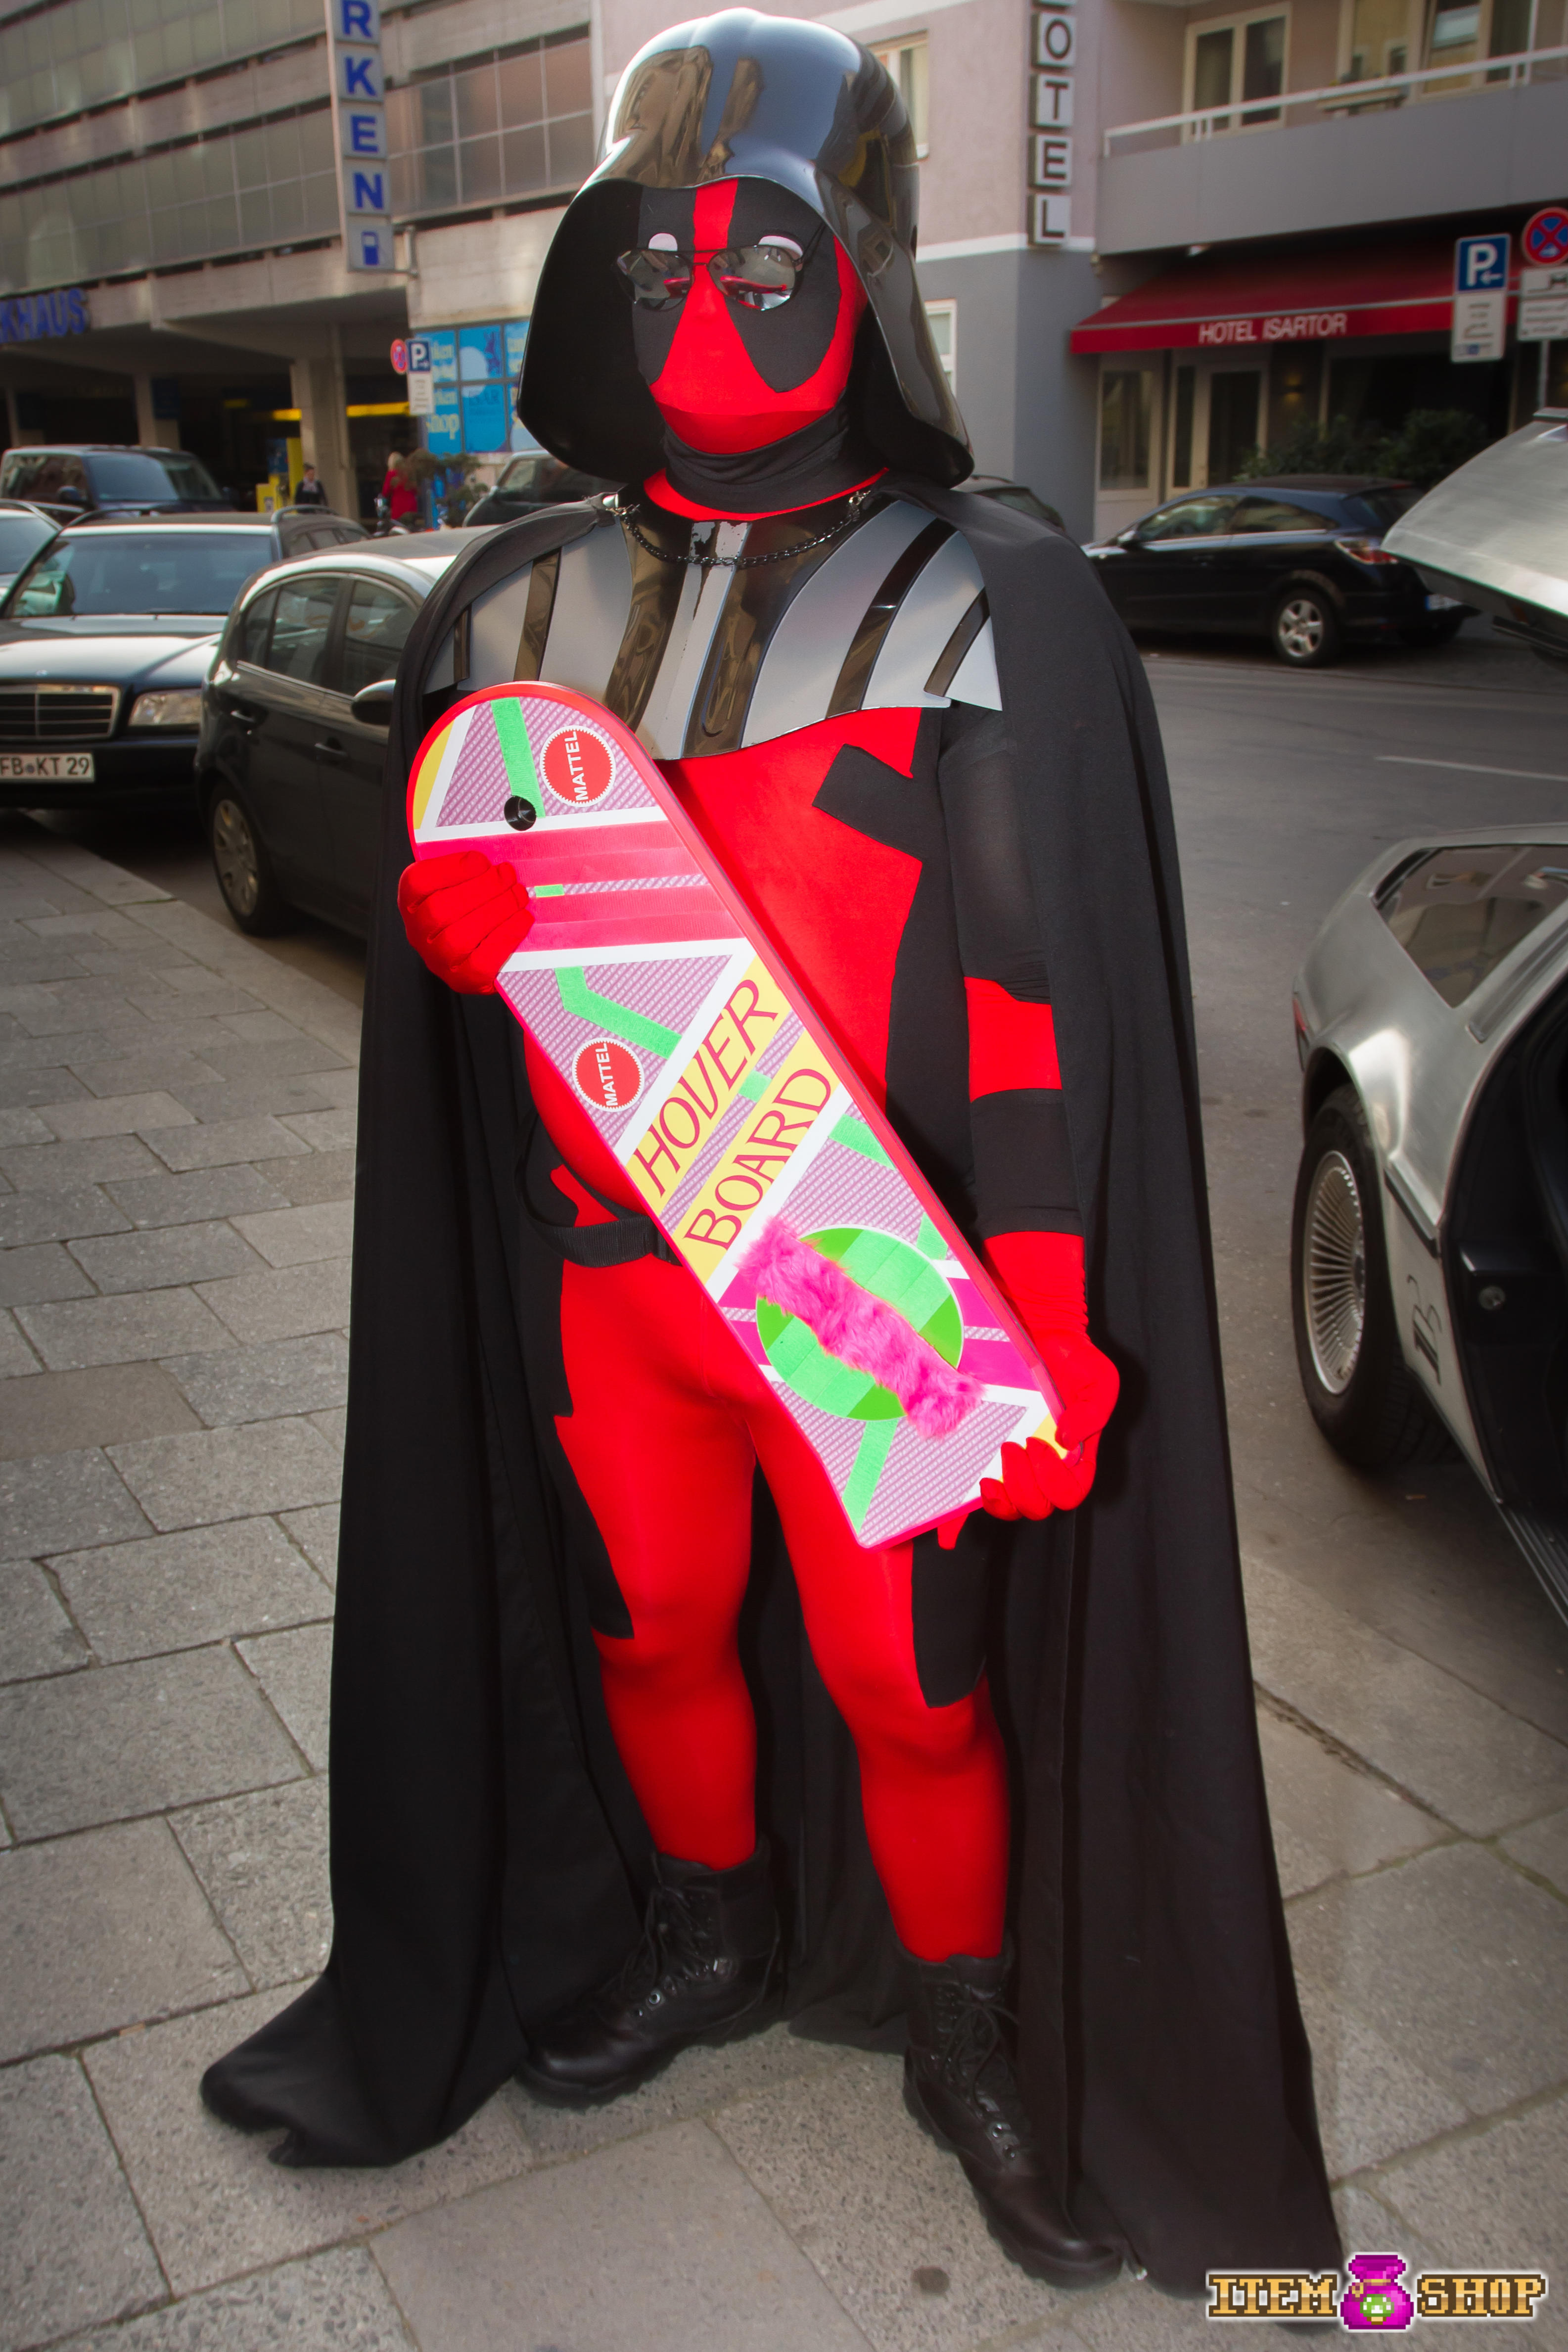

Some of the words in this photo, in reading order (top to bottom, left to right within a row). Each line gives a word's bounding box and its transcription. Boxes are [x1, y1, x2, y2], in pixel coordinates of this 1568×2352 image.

[1042, 18, 1072, 238] OTEL
[1467, 243, 1498, 286] P
[1198, 320, 1257, 343] HOTEL
[1262, 313, 1348, 340] ISARTOR
[36, 757, 60, 776] KT
[66, 757, 90, 775] 29
[564, 731, 589, 801] MATTEL
[595, 1042, 618, 1106] MATTEL
[633, 979, 779, 1198] HOVER
[683, 1068, 831, 1250] BOARD
